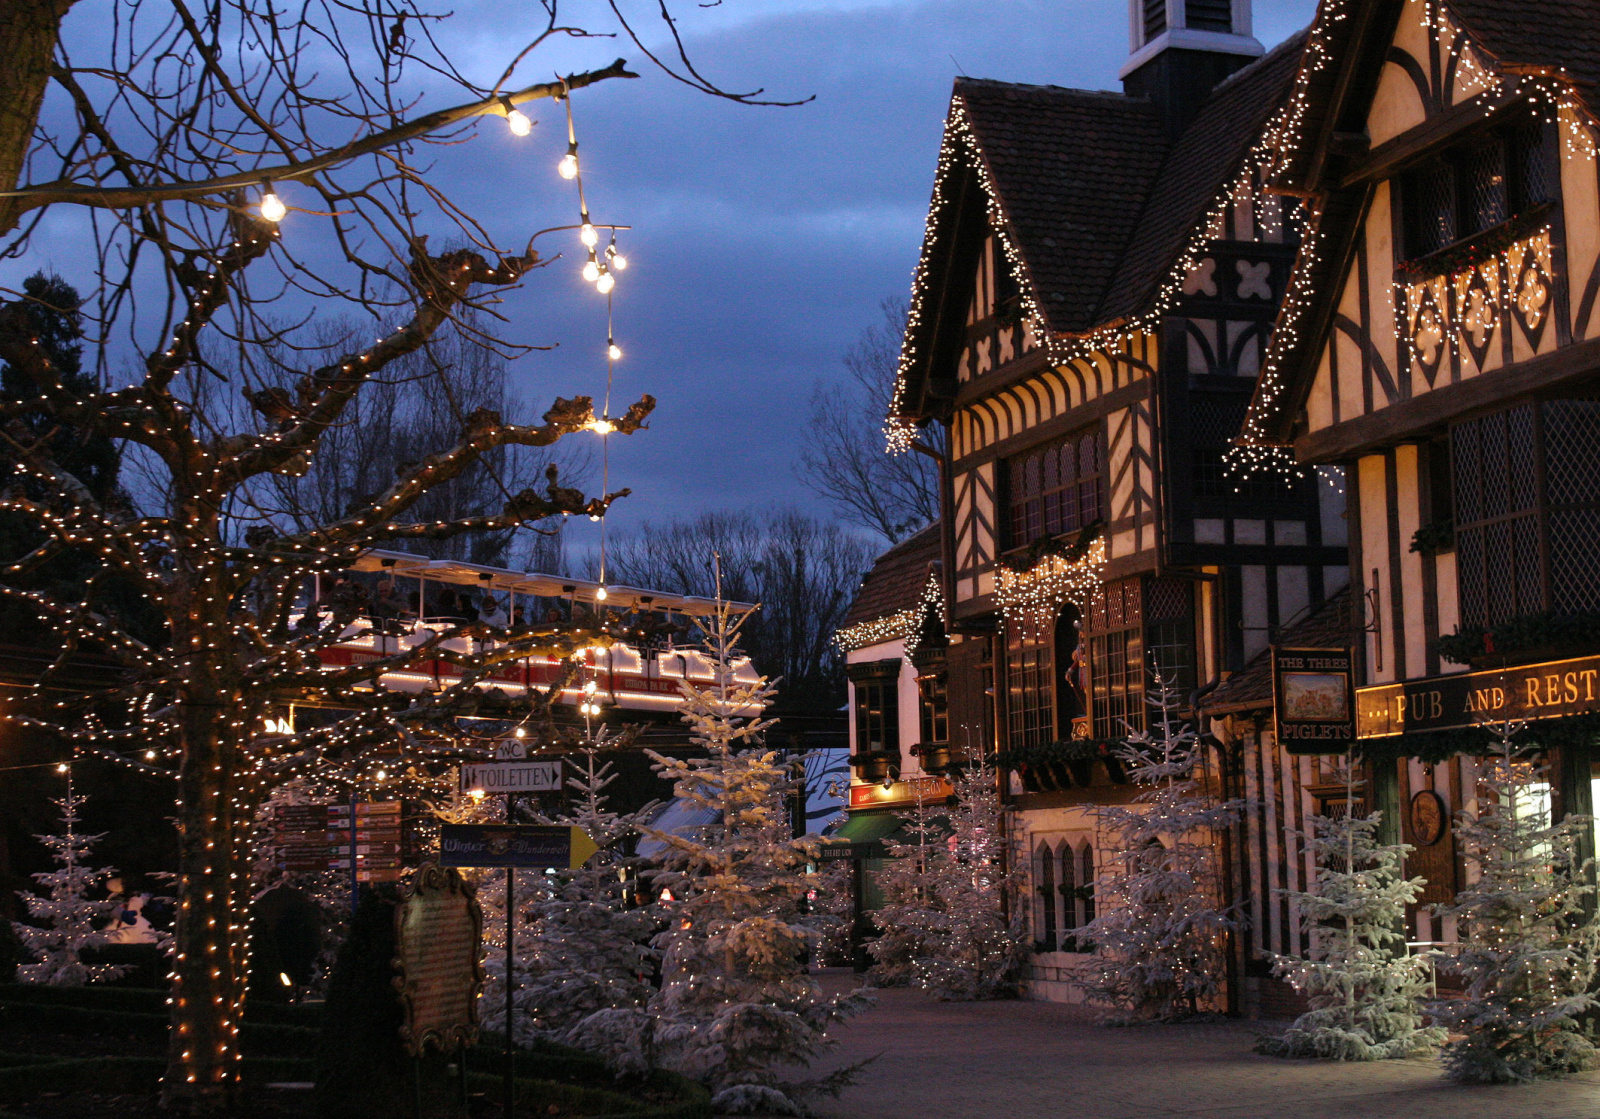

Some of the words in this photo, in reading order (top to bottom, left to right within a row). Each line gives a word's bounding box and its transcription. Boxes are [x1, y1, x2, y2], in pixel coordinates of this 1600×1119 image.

[1278, 657, 1304, 669] THE
[1306, 657, 1349, 669] THREE
[624, 679, 648, 690] EUROPA
[1463, 687, 1504, 713] AND
[1525, 669, 1598, 708] REST
[1281, 722, 1352, 740] PIGLETS
[500, 740, 522, 758] WC
[478, 767, 551, 787] TOILETTEN
[443, 838, 486, 853] Winter
